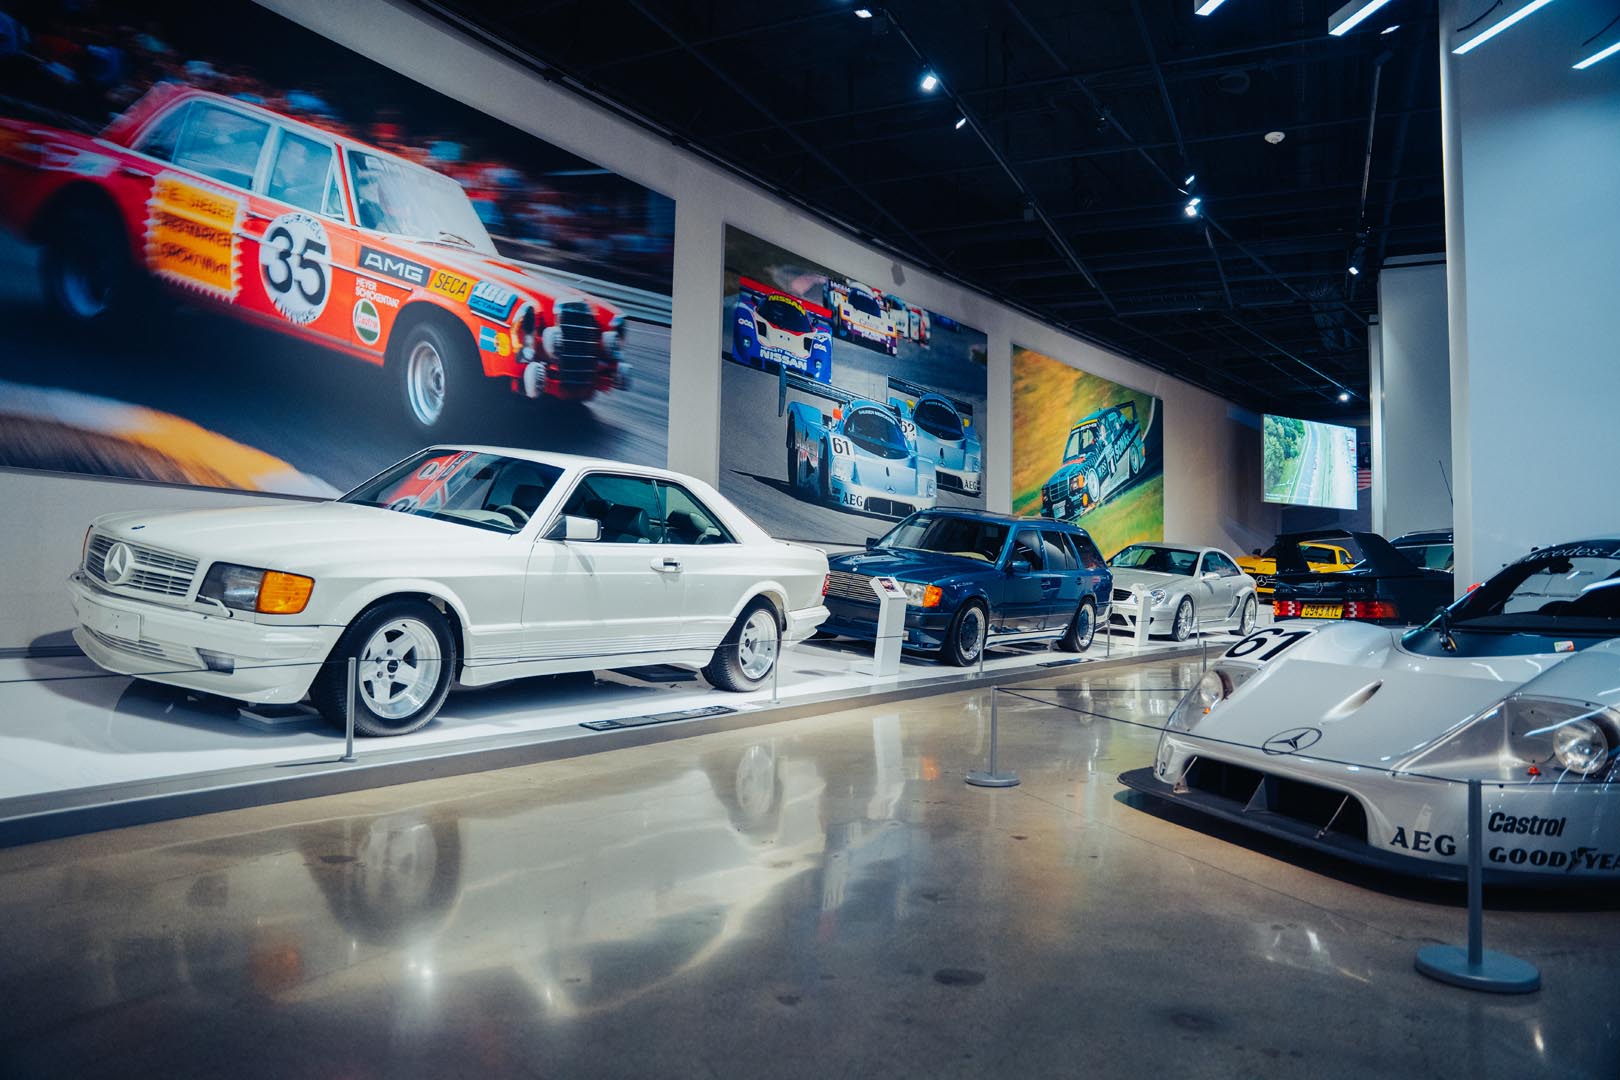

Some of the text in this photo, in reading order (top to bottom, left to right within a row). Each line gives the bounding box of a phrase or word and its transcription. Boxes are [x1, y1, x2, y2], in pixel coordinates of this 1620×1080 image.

[267, 226, 327, 306] 35
[364, 252, 424, 282] AMG
[434, 272, 467, 296] SECA
[768, 295, 806, 316] NISSAN
[760, 349, 808, 371] NISSAN
[833, 437, 850, 456] 61
[842, 492, 863, 507] AEG
[1225, 628, 1312, 661] 61
[1487, 811, 1567, 837] Castrol
[1389, 826, 1457, 857] AEG
